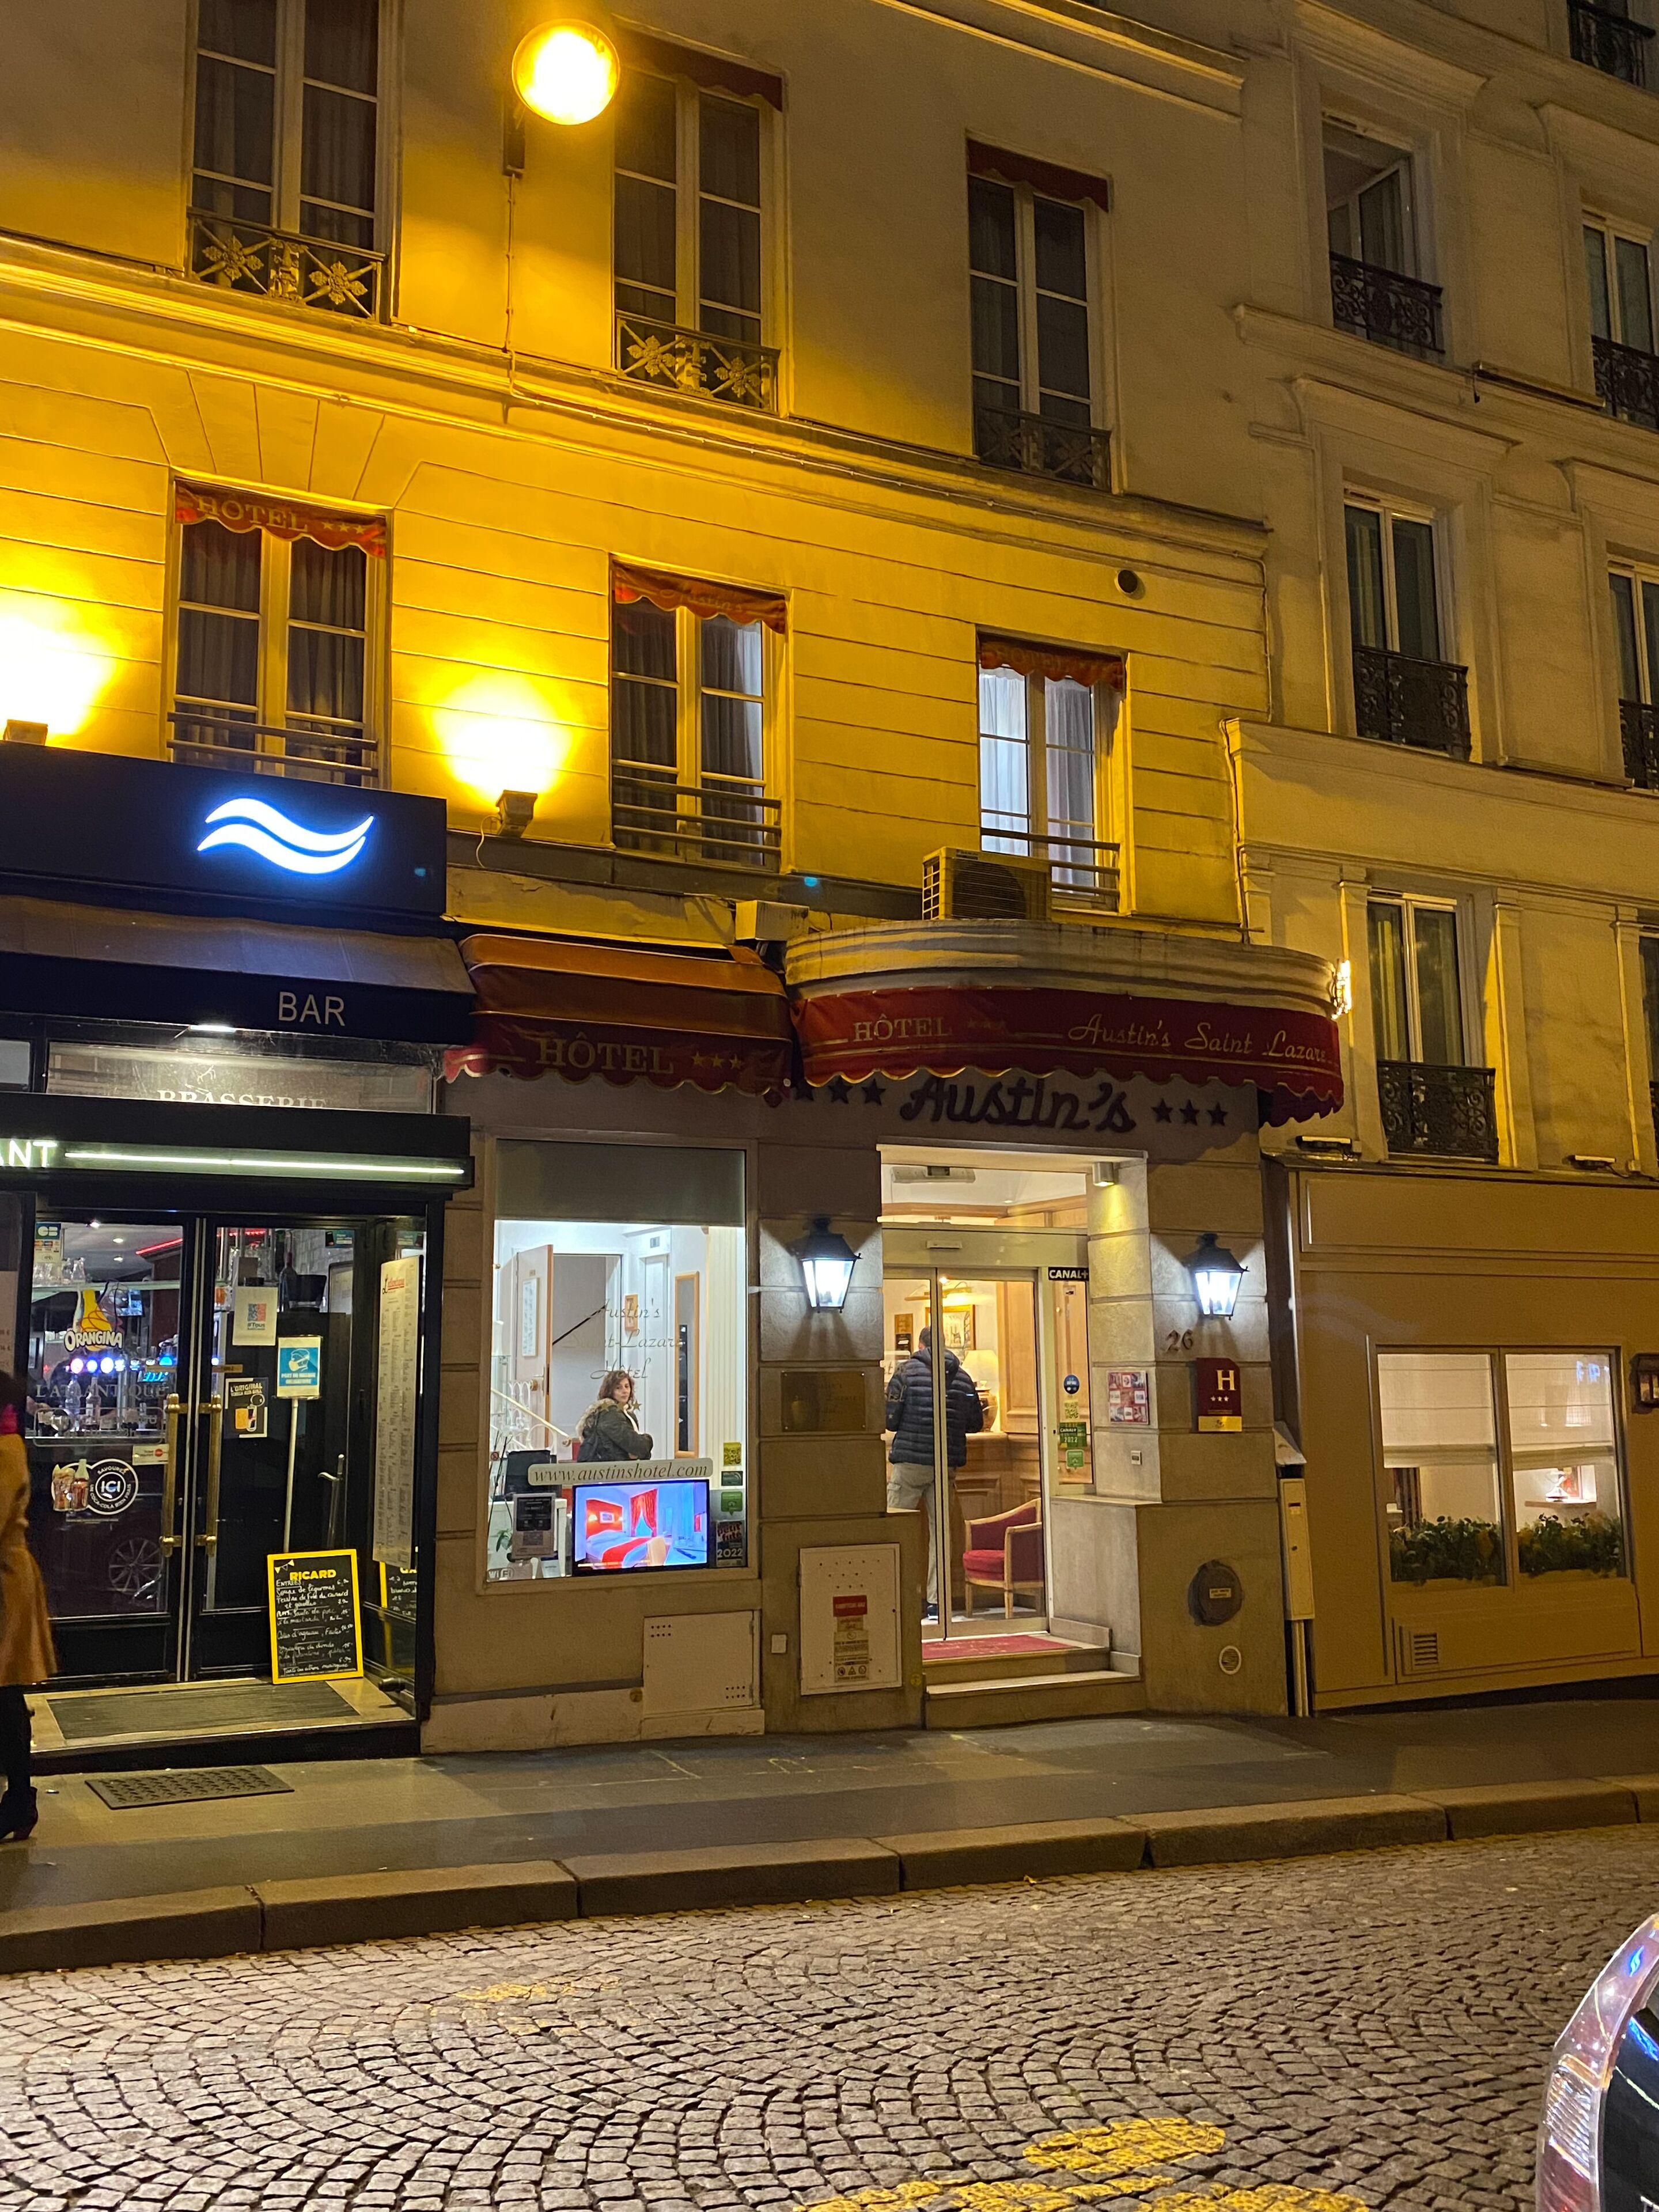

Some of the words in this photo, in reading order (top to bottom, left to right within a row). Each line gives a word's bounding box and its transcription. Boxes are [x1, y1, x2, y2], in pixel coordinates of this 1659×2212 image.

[278, 991, 345, 1027] BAR
[853, 1014, 950, 1041] HÔTEL
[1068, 1014, 1171, 1047] Austin's
[1184, 1022, 1253, 1053] Saint
[536, 1031, 673, 1074] HÔTEL
[900, 1076, 1137, 1133] Austin's
[0, 1140, 58, 1168] NT
[1050, 1270, 1088, 1279] CANAL+
[65, 1330, 123, 1352] ORANGINA
[1166, 1330, 1193, 1351] 26
[1217, 1370, 1236, 1391] H
[534, 1462, 707, 1482] www.austinshotel.com
[101, 1481, 120, 1492] ICI
[718, 1548, 743, 1558] 2022
[290, 1569, 336, 1581] RICARD
